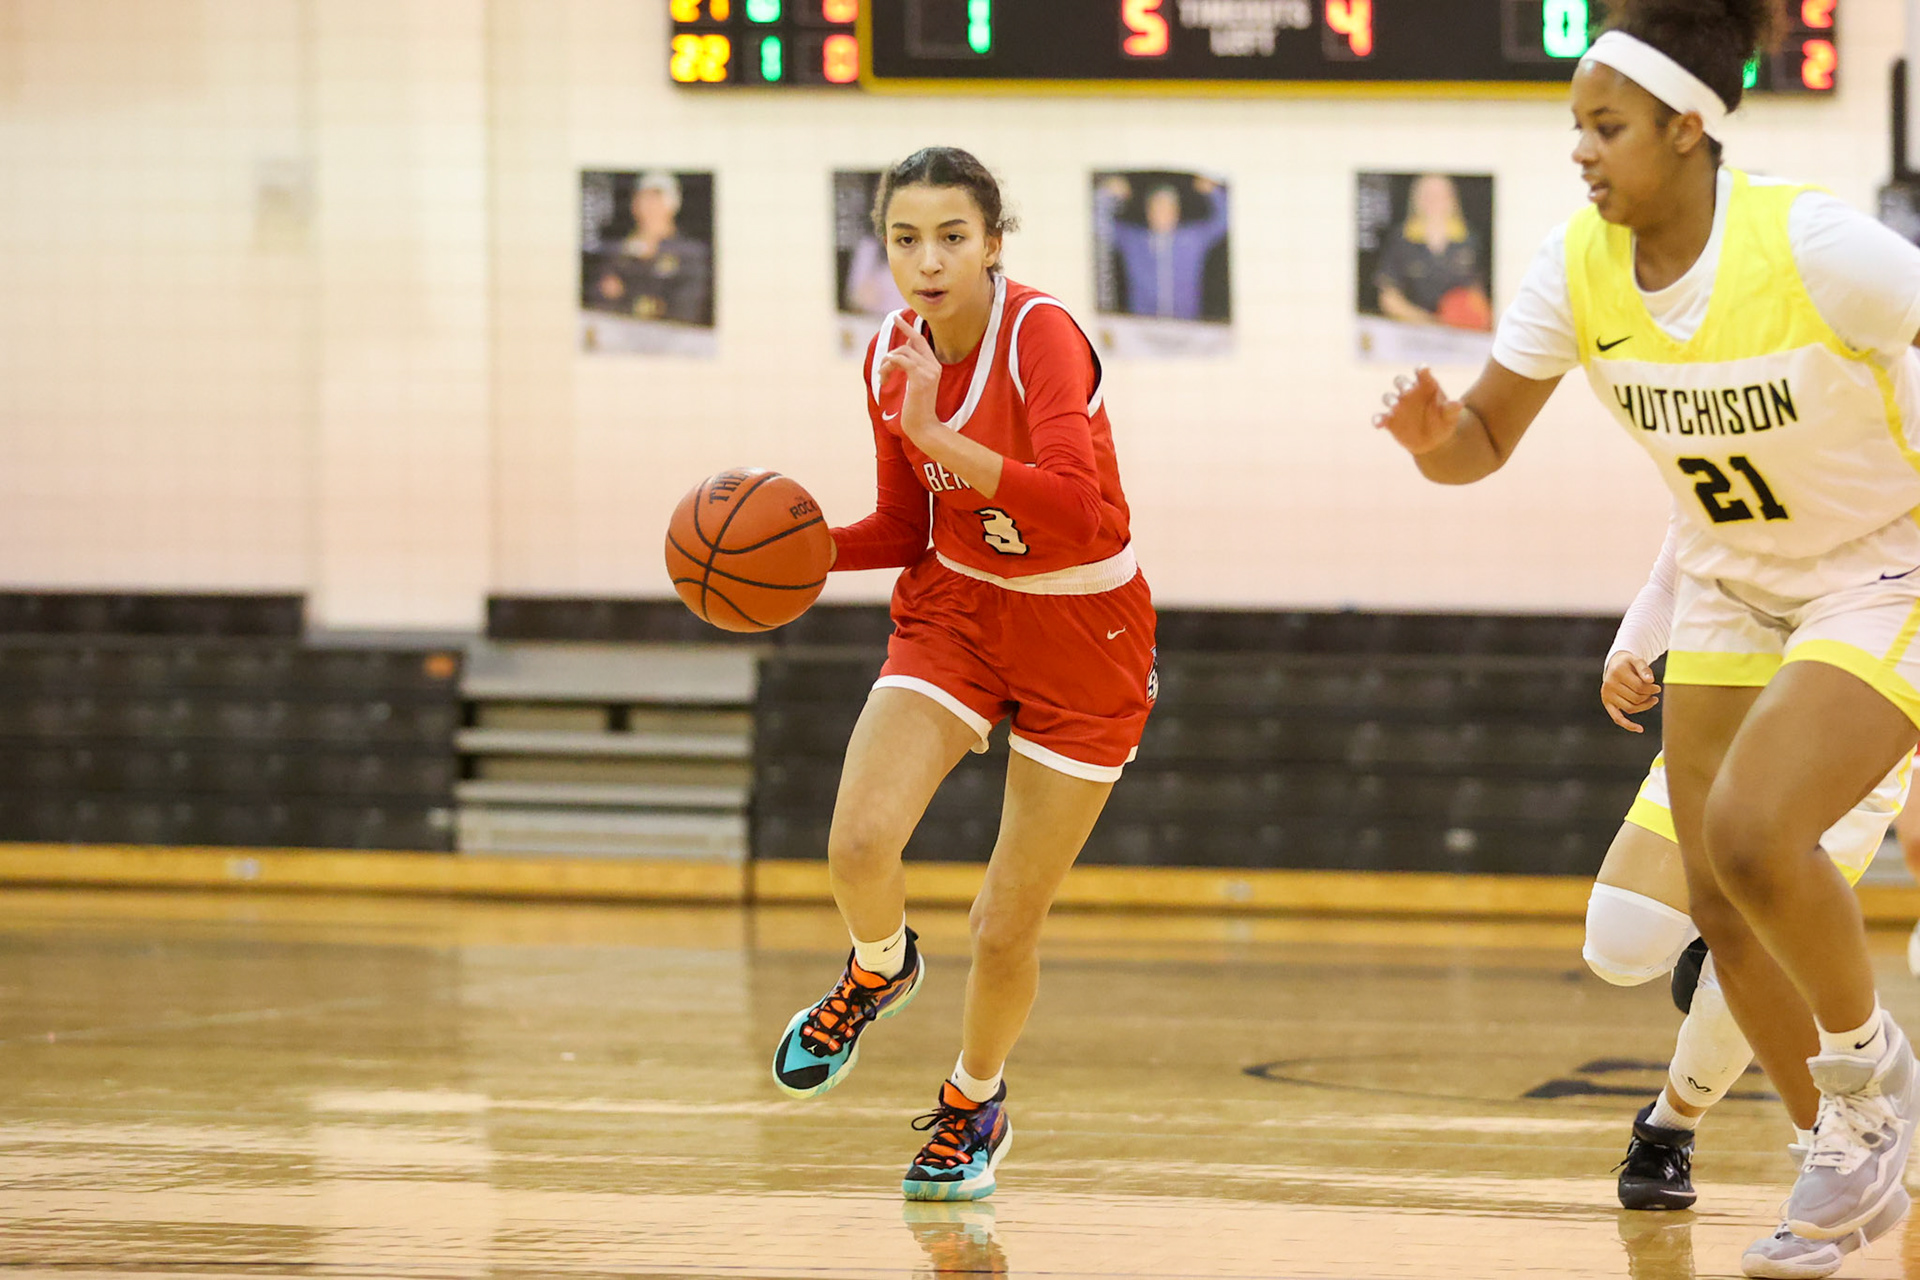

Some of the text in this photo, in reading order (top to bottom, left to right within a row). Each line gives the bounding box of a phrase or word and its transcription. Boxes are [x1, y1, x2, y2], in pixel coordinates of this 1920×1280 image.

[968, 0, 990, 53] 1
[1122, 0, 1169, 55] 5
[1325, 0, 1372, 56] 4
[1542, 0, 1589, 58] 0
[1802, 39, 1838, 90] 2
[1613, 378, 1798, 435] HUTCHISON
[1676, 455, 1790, 524] 21
